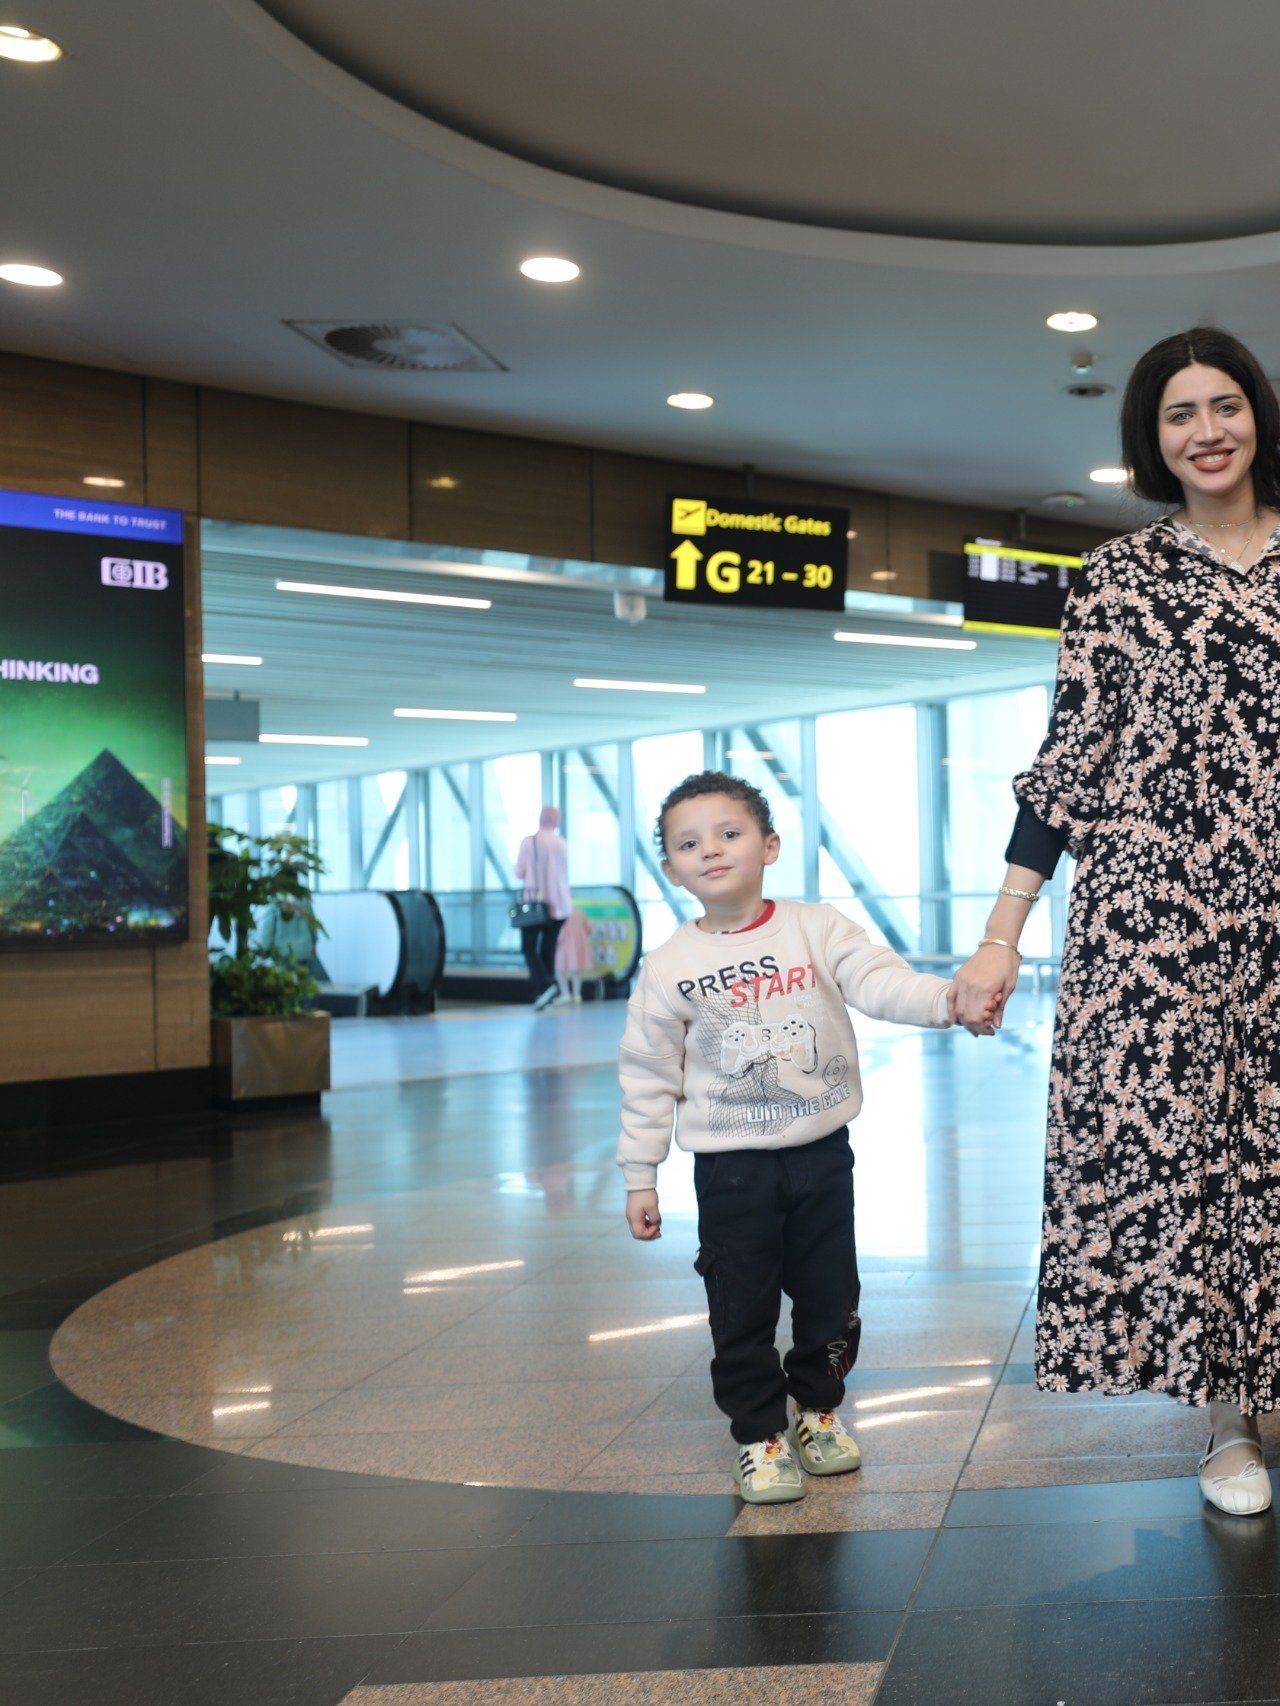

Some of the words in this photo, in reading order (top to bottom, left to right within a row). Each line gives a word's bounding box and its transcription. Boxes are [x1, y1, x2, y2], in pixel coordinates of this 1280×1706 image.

[53, 508, 76, 521] THE
[78, 511, 110, 524] BANK
[113, 514, 129, 527] TO
[131, 517, 168, 530] TRUST
[706, 508, 782, 532] Domestic
[784, 515, 831, 536] Gates
[101, 556, 170, 590] CIB
[706, 550, 741, 593] G
[746, 560, 775, 585] 21
[802, 563, 833, 589] 30
[677, 955, 779, 1001] PRESS
[730, 961, 816, 1008] START
[788, 1096, 820, 1118] THE
[821, 1081, 851, 1110] GAME
